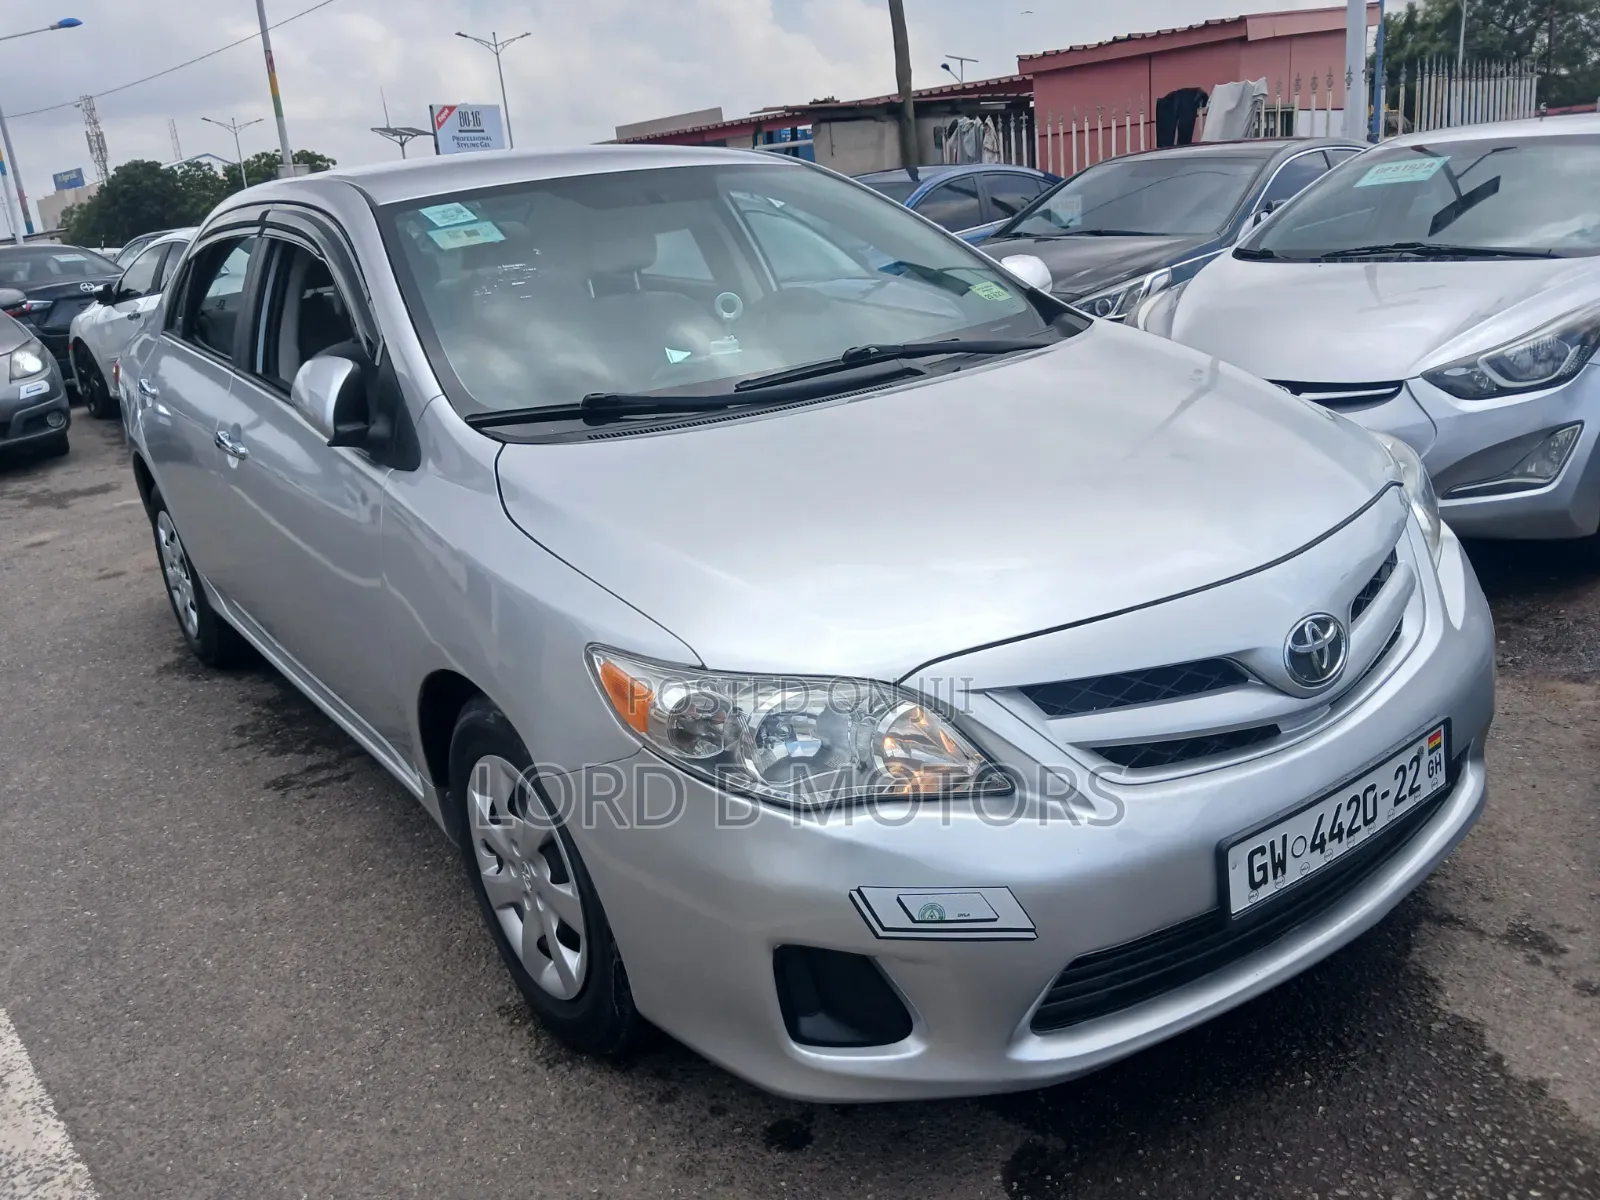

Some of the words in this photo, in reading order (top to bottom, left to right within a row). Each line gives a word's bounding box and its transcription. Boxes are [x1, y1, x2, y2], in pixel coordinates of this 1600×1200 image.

[437, 108, 450, 123] new
[1427, 752, 1442, 779] GH
[1247, 832, 1288, 891] GW
[1309, 753, 1422, 856] 4420-22
